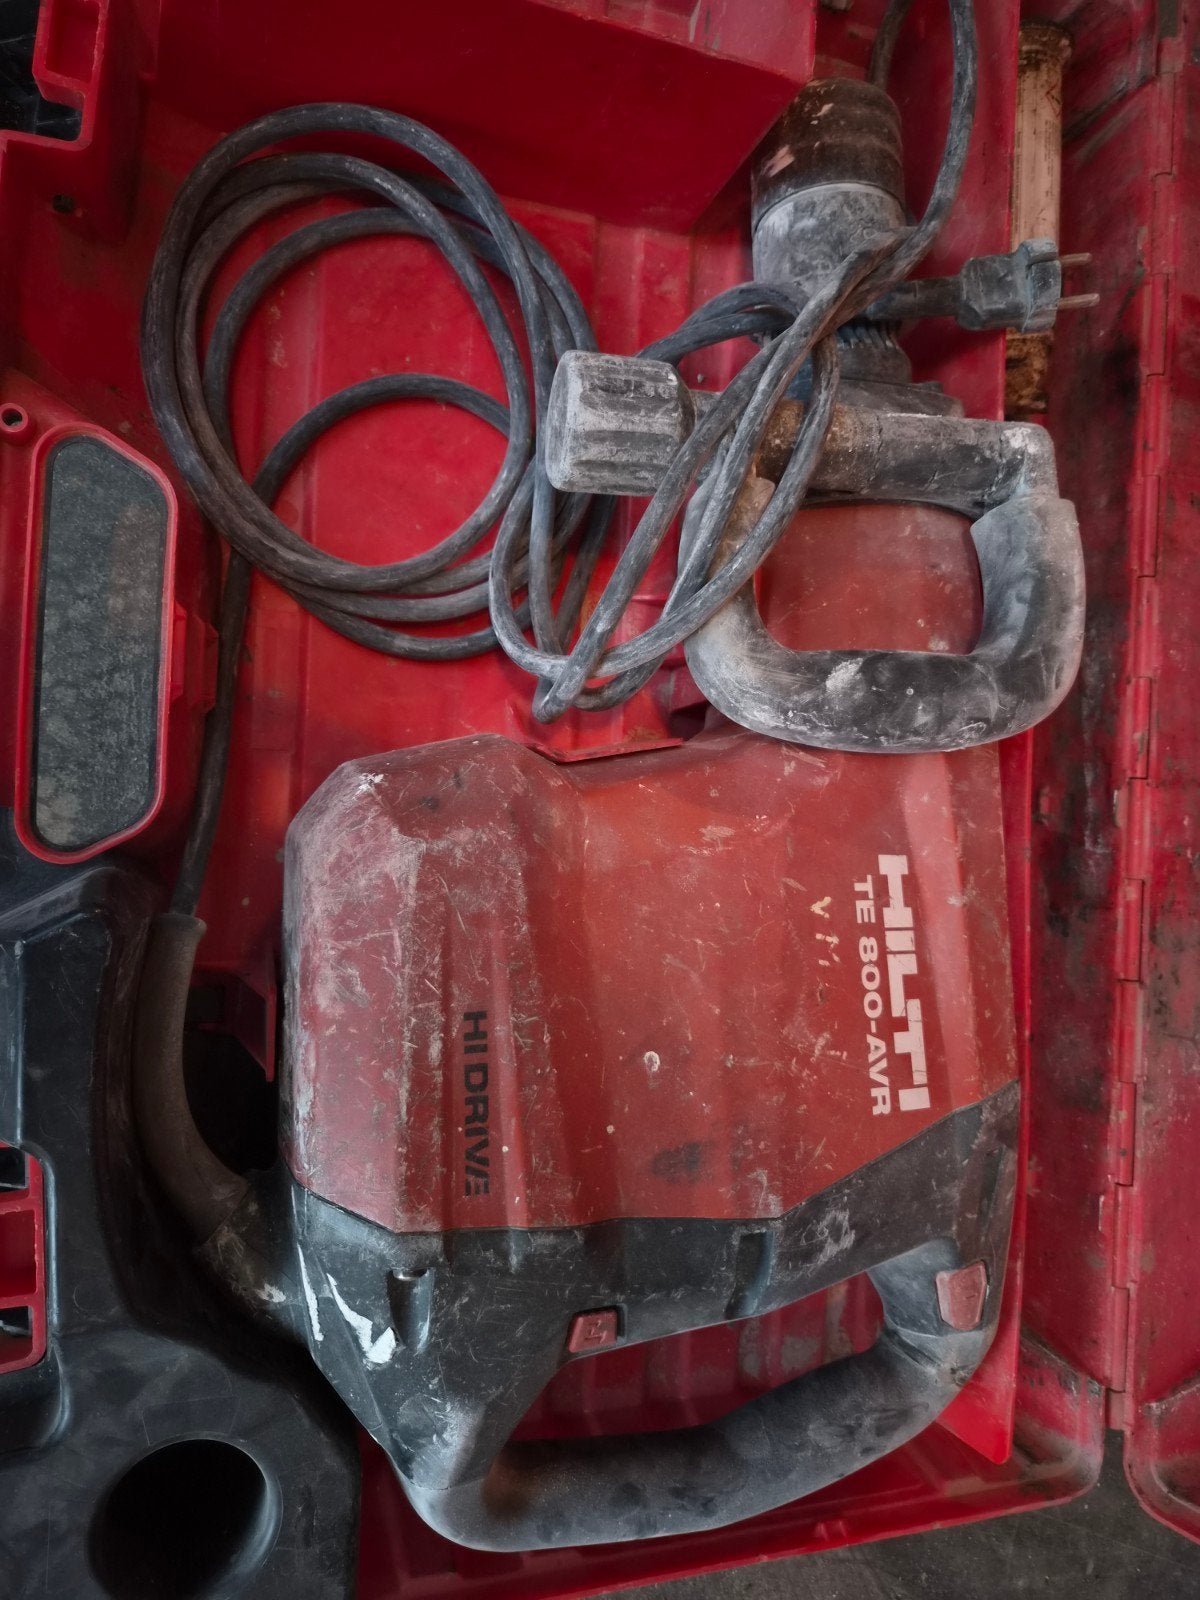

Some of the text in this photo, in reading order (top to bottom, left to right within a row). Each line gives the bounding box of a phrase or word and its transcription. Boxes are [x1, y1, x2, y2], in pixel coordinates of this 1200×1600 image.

[463, 1010, 490, 1196] HI DRIVE
[854, 874, 892, 1116] TE 800-AVR
[878, 854, 931, 1111] HILTI
